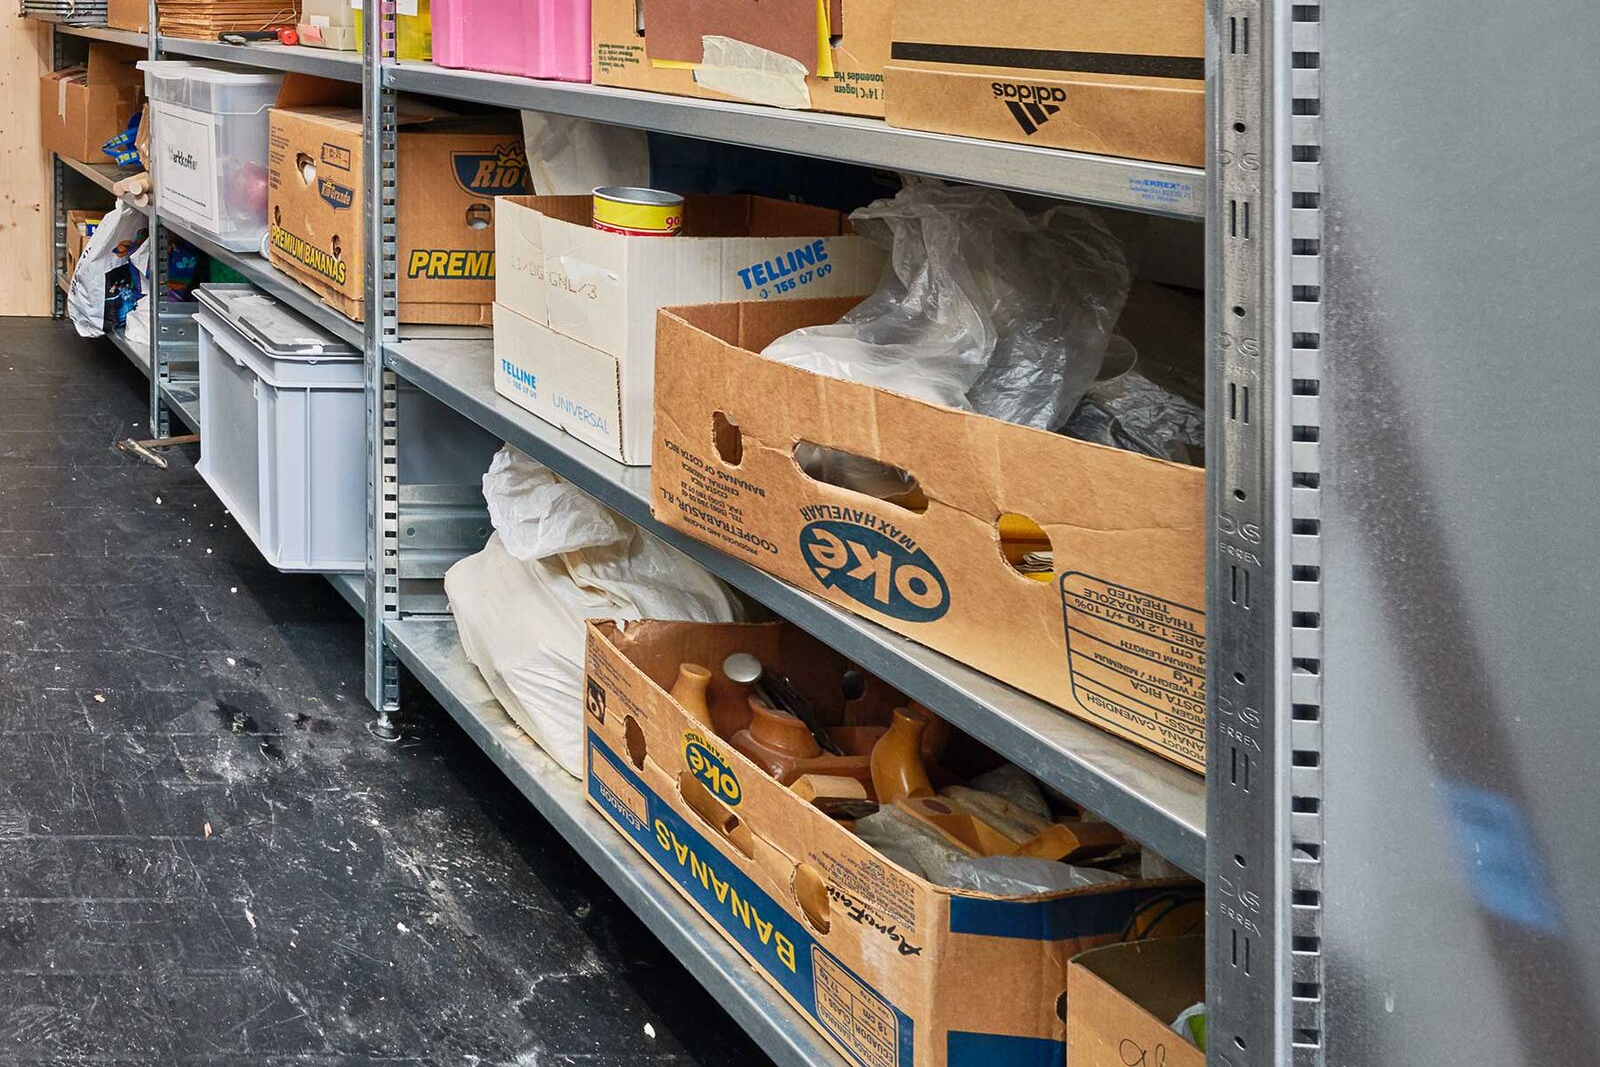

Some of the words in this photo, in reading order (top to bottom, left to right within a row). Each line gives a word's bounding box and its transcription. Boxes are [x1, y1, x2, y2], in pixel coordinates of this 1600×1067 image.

[991, 82, 1067, 104] adidas
[271, 224, 304, 262] PREMIUM
[305, 245, 346, 285] BANANAS
[408, 250, 496, 279] PREMI
[737, 239, 828, 290] TELLINE
[799, 271, 813, 284] 07
[816, 263, 832, 278] 09
[501, 358, 536, 390] TELLINE
[552, 393, 609, 435] UNIVERSAL
[681, 449, 703, 468] COSTA
[705, 465, 715, 475] OF
[717, 471, 765, 497] BANANAS
[800, 505, 876, 528] HAVELAAR
[878, 520, 916, 551] MAX
[1074, 598, 1100, 614] 10%
[1083, 588, 1197, 633] THIABENDAZOLE
[1107, 588, 1170, 614] TREATED
[1127, 615, 1145, 629] Kg
[1120, 640, 1160, 660] LENGTH
[1172, 631, 1206, 648] ARE:
[1094, 652, 1138, 675] MINIMUM
[1171, 646, 1193, 659] cm
[1163, 655, 1206, 674] INIMUM
[1130, 680, 1162, 699] RICA
[1147, 675, 1189, 694] WEIGHT
[1173, 670, 1193, 687] Kg
[1166, 694, 1206, 713] OSTA
[1192, 691, 1206, 700] ET
[1086, 694, 1156, 731] CAVENDISH
[1171, 707, 1205, 724] RIGEN
[1165, 717, 1205, 738] LASS:
[1159, 727, 1205, 752] ANANA
[1162, 738, 1204, 761] RODUCT
[599, 784, 641, 831] ECUADOR
[655, 819, 796, 973] BANANAS
[855, 1024, 893, 1063] ECUADOR
